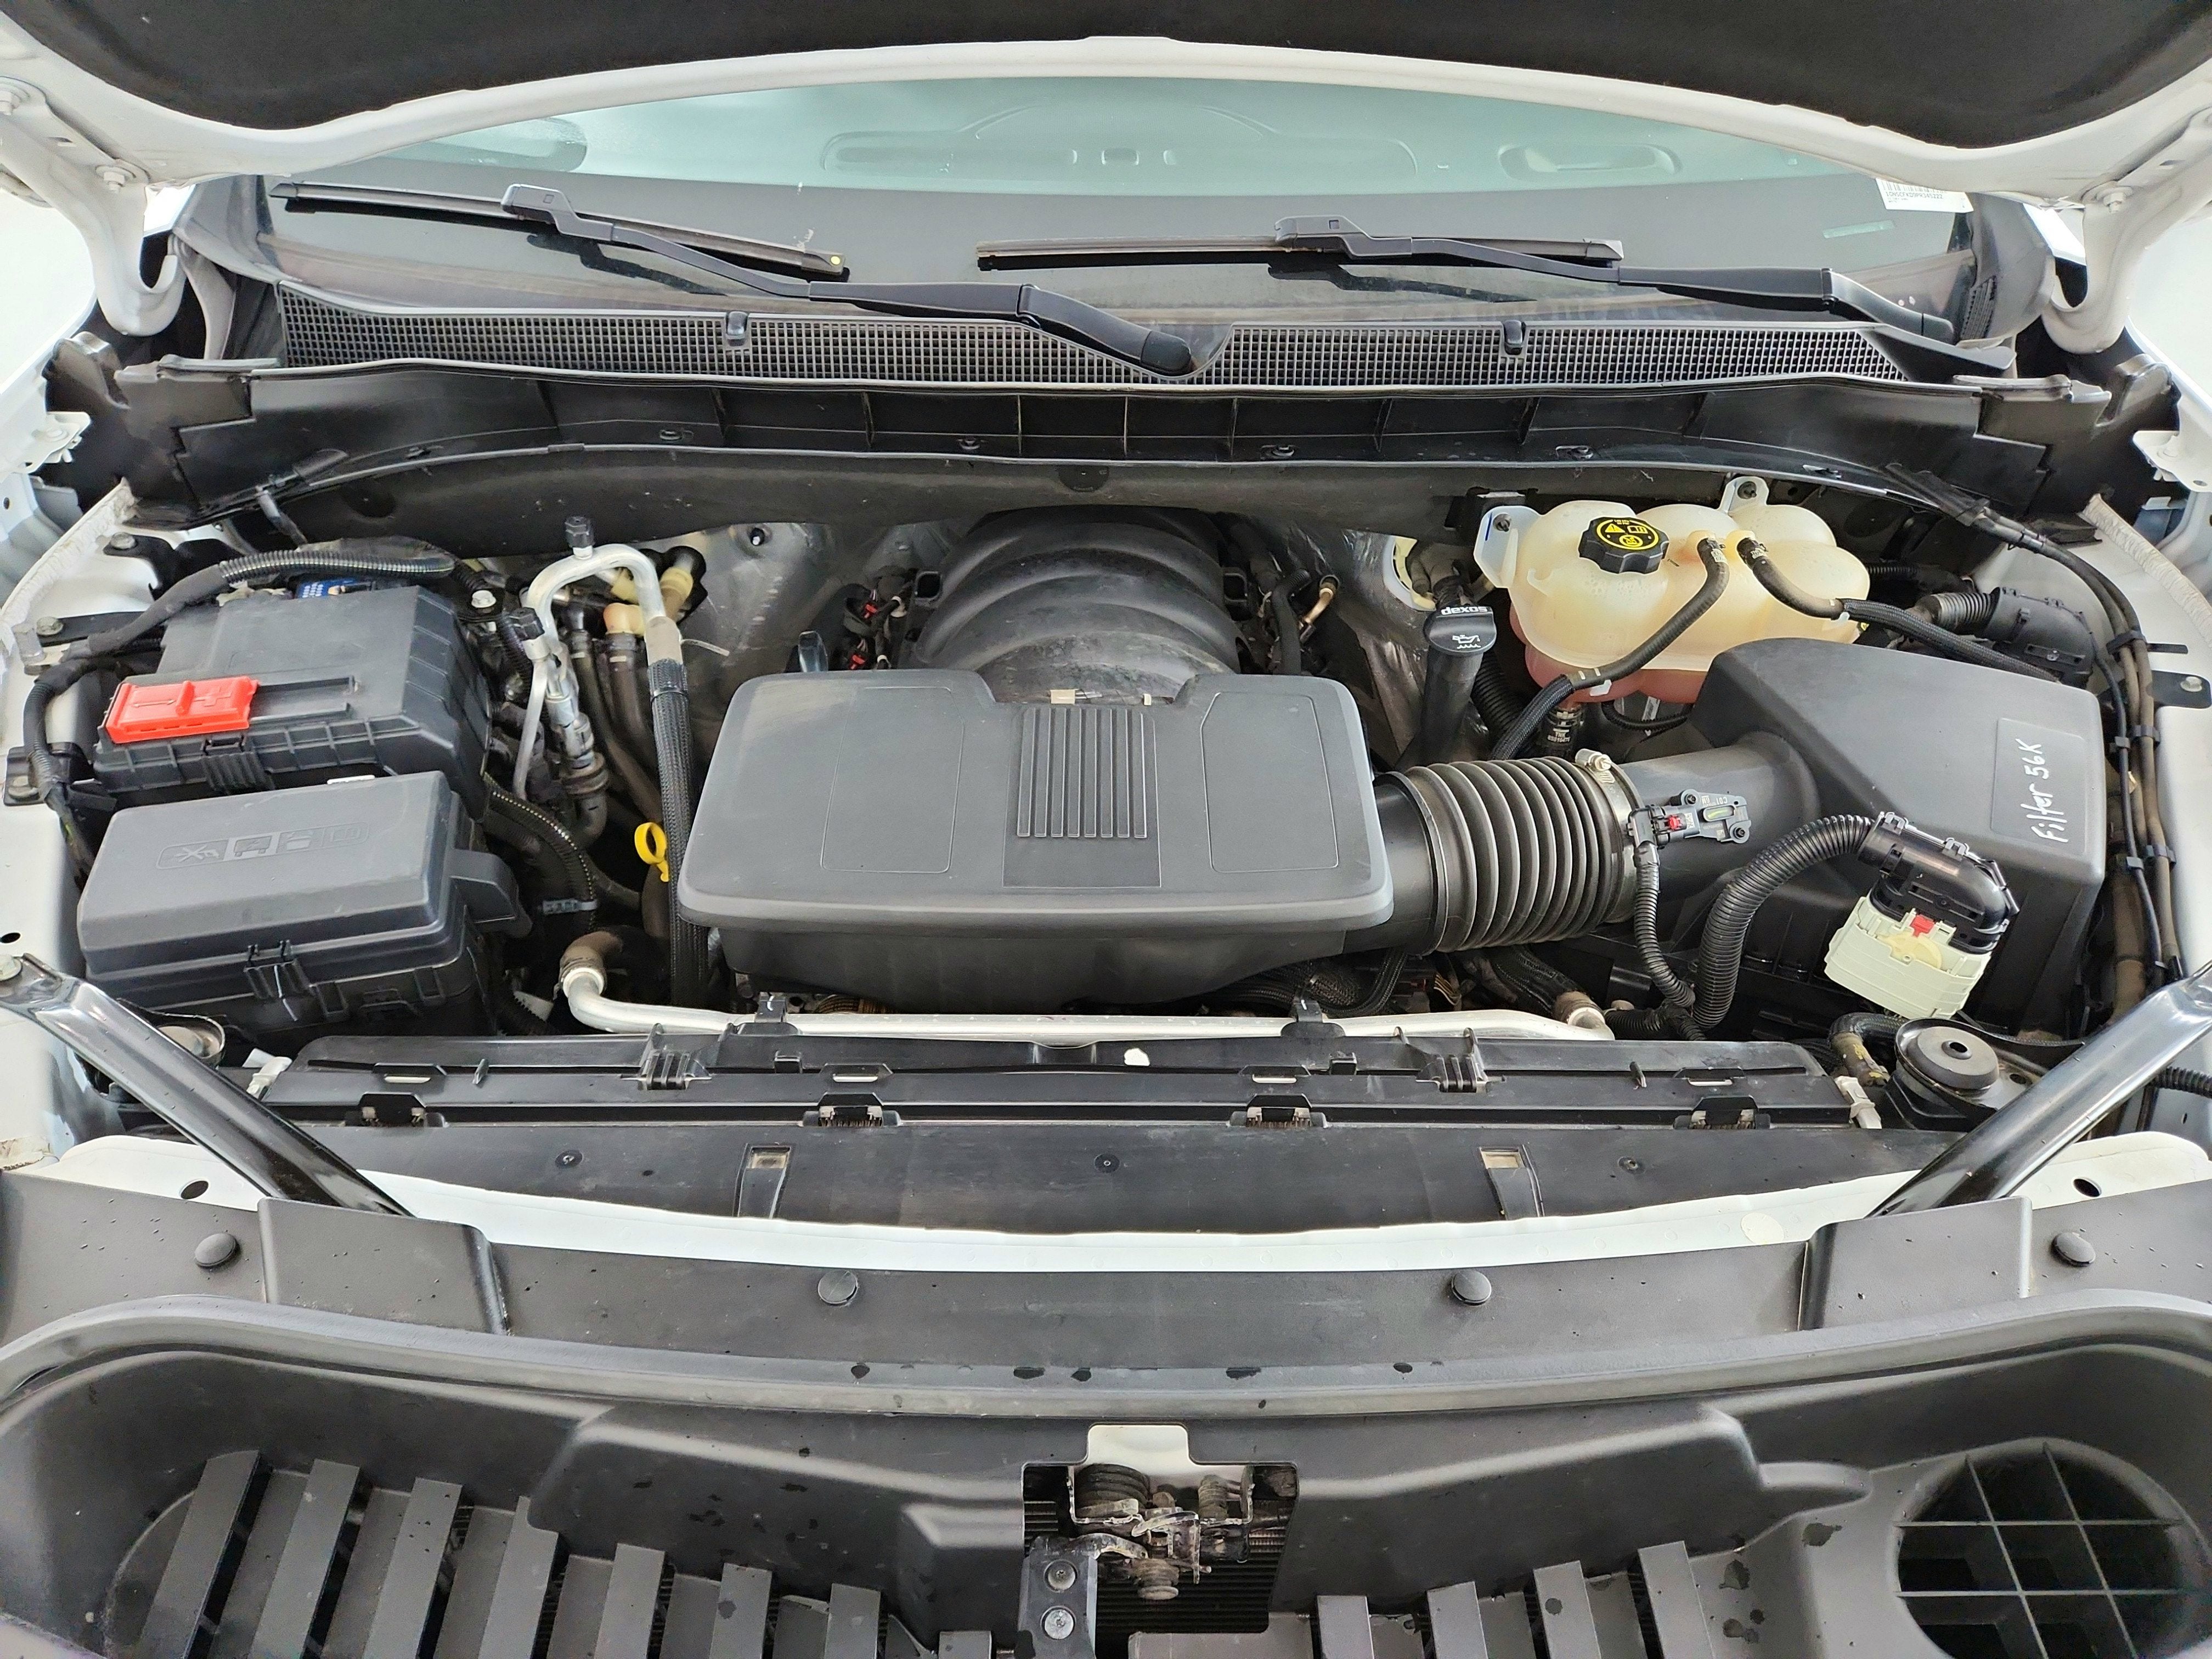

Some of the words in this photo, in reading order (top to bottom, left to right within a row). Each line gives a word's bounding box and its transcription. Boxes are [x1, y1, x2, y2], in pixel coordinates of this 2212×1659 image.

[1441, 606, 1488, 616] dexos
[2015, 738, 2049, 780] 56K
[2020, 783, 2068, 843] Filter
